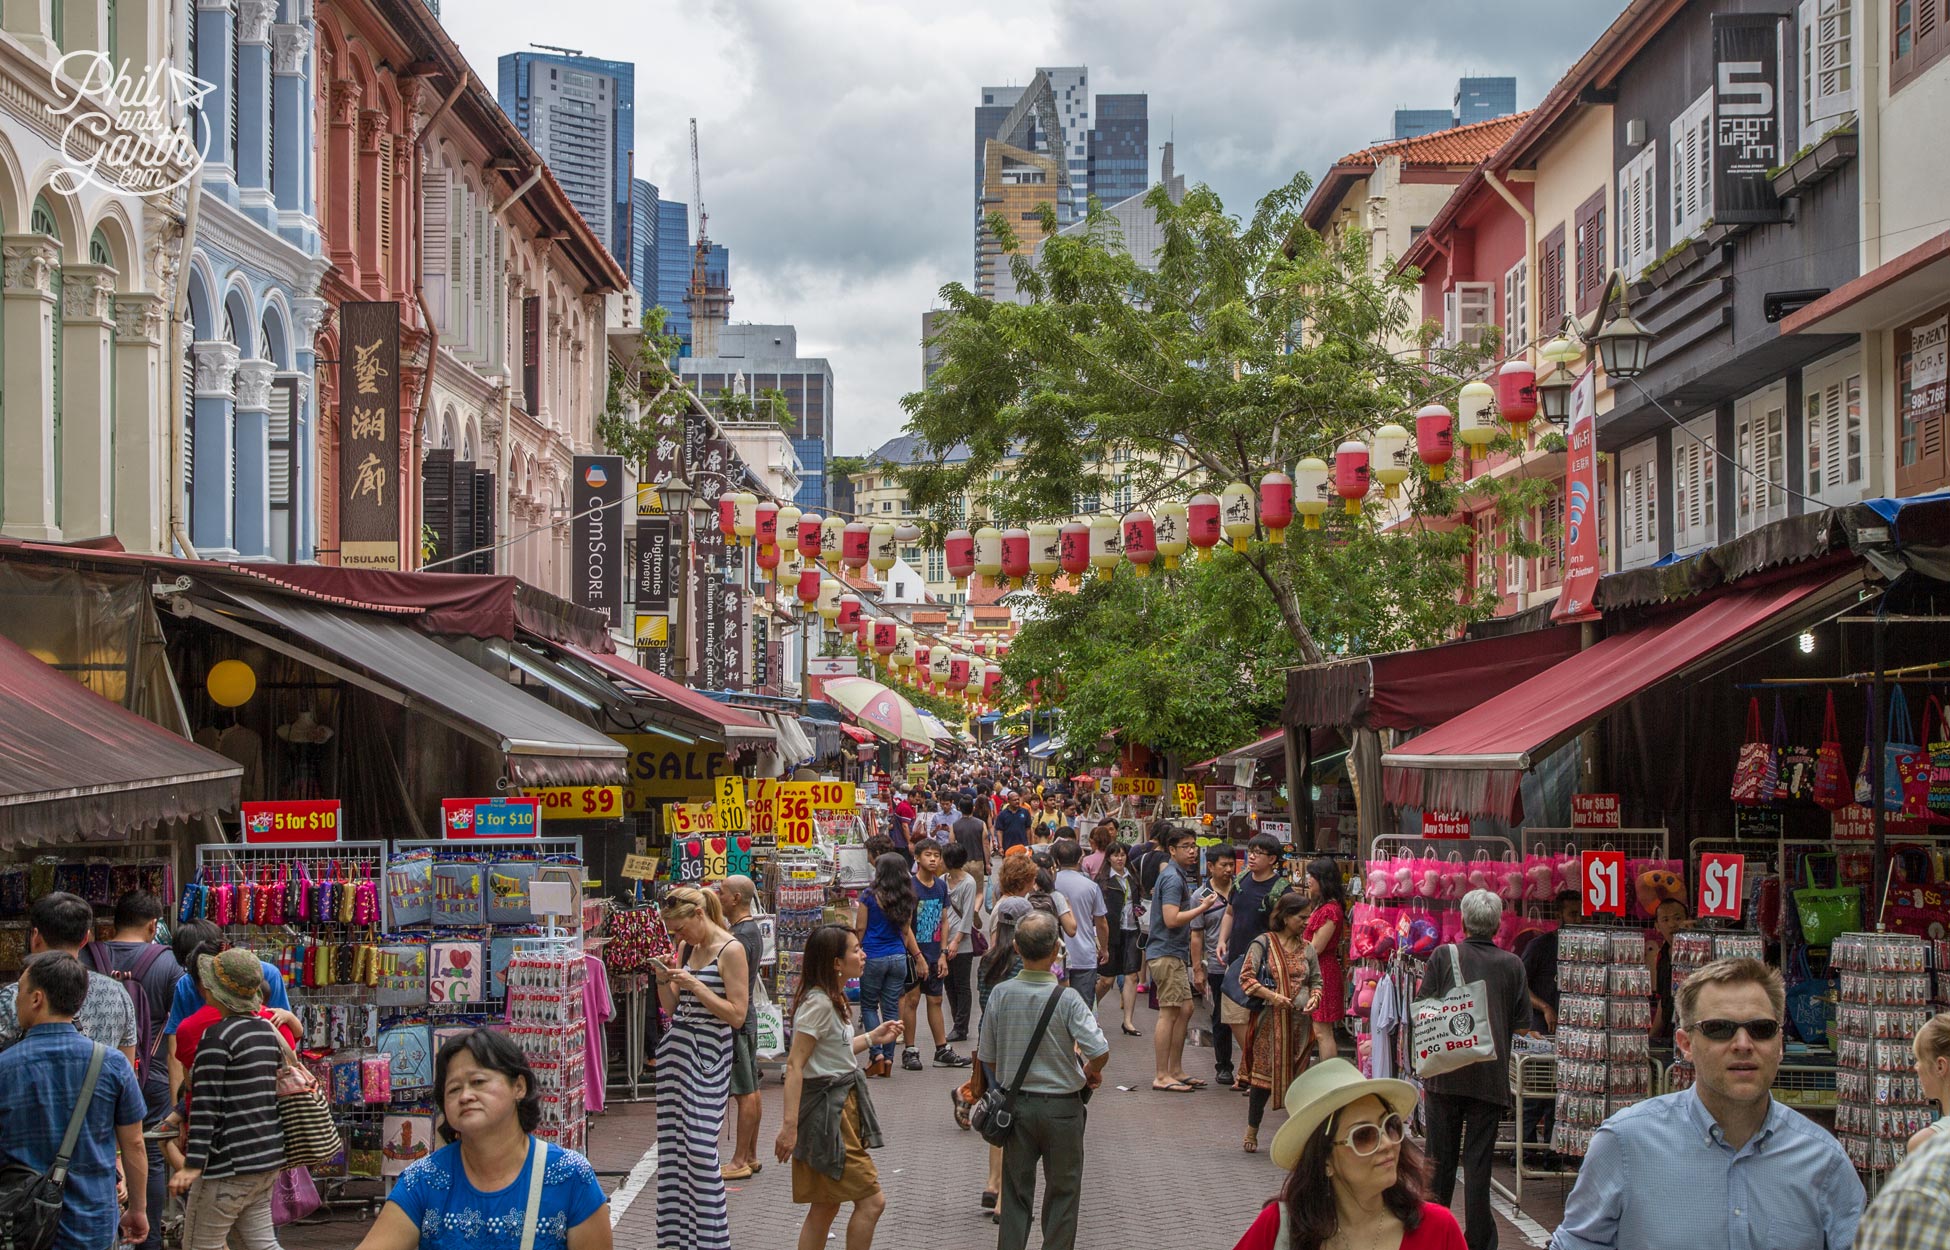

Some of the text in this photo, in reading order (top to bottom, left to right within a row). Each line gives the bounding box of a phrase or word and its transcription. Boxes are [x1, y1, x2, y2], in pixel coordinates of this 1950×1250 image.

[1718, 61, 1773, 115] 5
[1719, 118, 1773, 132] FOOT
[1719, 132, 1761, 146] WAY
[685, 418, 695, 464] Chinatown
[1573, 429, 1590, 450] Wi-Fi
[638, 504, 665, 514] Niko
[342, 555, 396, 564] YISULANG
[653, 535, 664, 596] Digitronics
[725, 545, 733, 570] entre
[642, 552, 653, 593] Synergy
[636, 637, 667, 647] Nikon
[706, 577, 716, 691] Chinatown Heritage Centre
[1585, 757, 1592, 774] 1
[724, 777, 733, 796] 5
[757, 779, 767, 799] 7
[810, 784, 843, 804] $10
[1100, 779, 1155, 793] 5 FOR $10
[1179, 785, 1194, 800] 36
[582, 789, 614, 814] $9
[722, 797, 735, 805] FOR
[750, 799, 773, 812] OR
[781, 797, 809, 820] 36
[1576, 799, 1580, 810] 1
[1581, 799, 1593, 811] For
[275, 811, 336, 830] 5 for $10
[476, 812, 534, 826] 5 for $10
[676, 807, 715, 829] 5 FOR
[721, 806, 743, 829] $10
[1574, 811, 1618, 825] Any 2 For $12
[1842, 808, 1846, 820] 1
[1848, 808, 1860, 820] For
[1424, 824, 1438, 835] Any
[1438, 824, 1444, 834] 3
[1456, 823, 1468, 834] $10
[1834, 822, 1848, 836] Any
[1849, 822, 1854, 834] 3
[1854, 822, 1866, 835] For
[680, 842, 689, 861] I
[681, 860, 703, 880] SG
[727, 854, 751, 873] SG
[1589, 857, 1619, 911] $1
[1704, 859, 1738, 913] $1
[394, 895, 432, 909] Singapor
[436, 900, 479, 912] Singapore
[1924, 890, 1941, 906] SG
[432, 948, 442, 978] I
[430, 980, 471, 1004] SG
[1427, 1044, 1441, 1054] SG
[1445, 1035, 1479, 1051] Bag!
